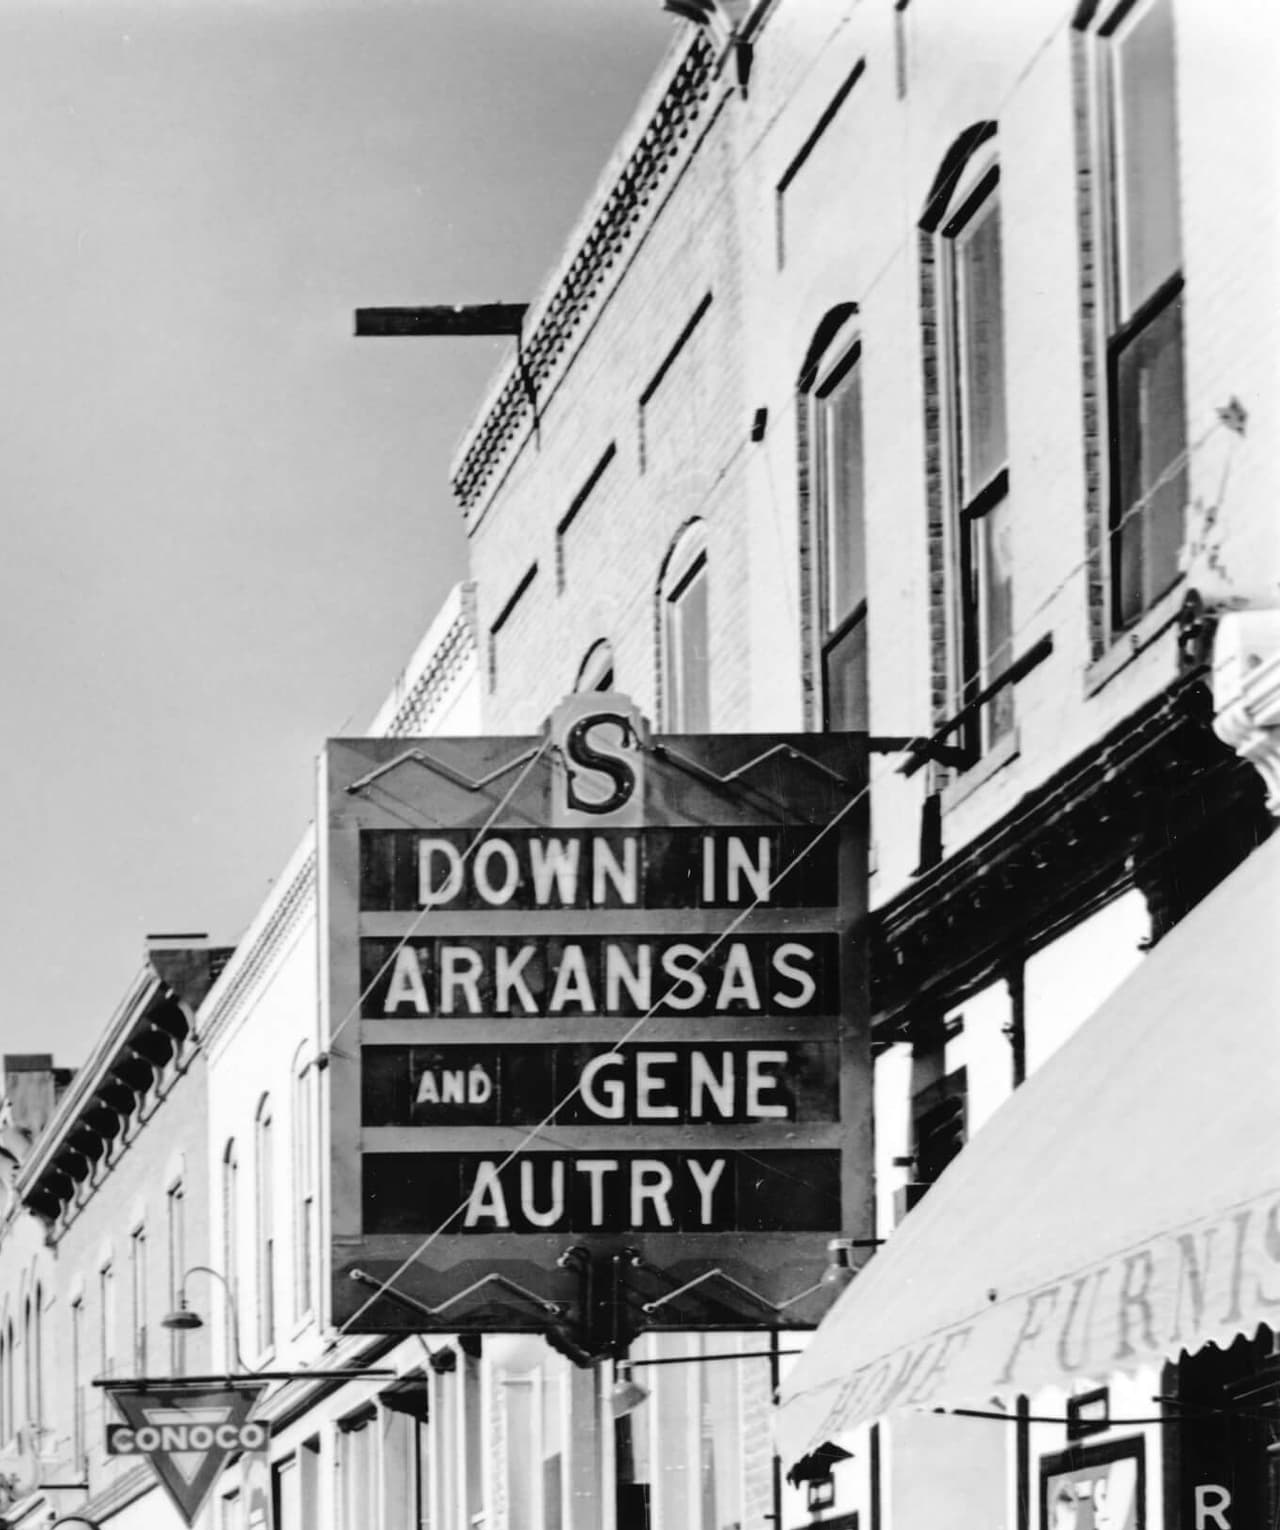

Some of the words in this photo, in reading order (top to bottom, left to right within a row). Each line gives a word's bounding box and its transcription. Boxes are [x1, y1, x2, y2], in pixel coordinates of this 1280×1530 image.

[418, 837, 637, 907] DOWN
[703, 835, 771, 903] IN
[383, 943, 817, 1014] ARKANSAS
[415, 1064, 493, 1105] AND
[579, 1050, 789, 1119] GENE
[464, 1157, 726, 1229] AUTRY
[111, 1423, 265, 1452] CONOCO
